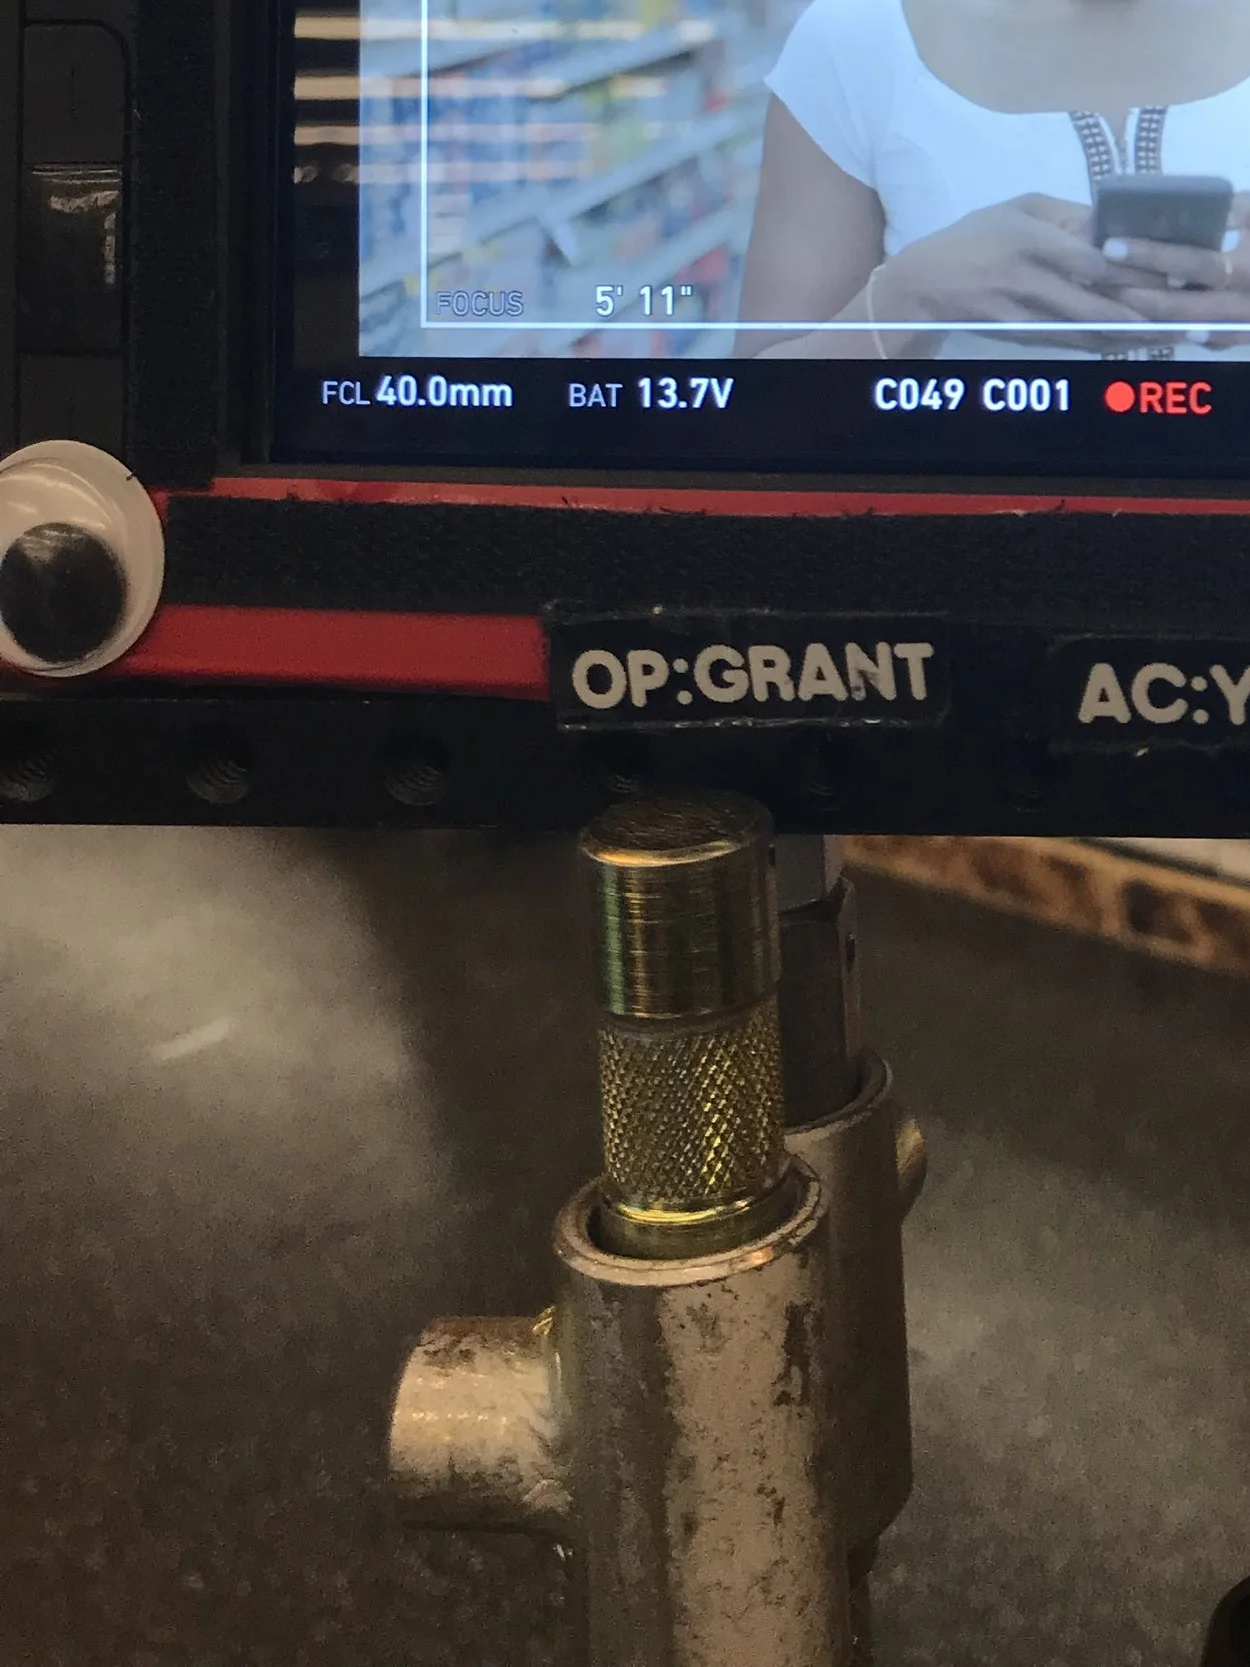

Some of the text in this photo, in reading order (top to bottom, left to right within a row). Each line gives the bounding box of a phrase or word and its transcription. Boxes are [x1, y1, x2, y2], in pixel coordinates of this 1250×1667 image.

[436, 291, 524, 317] FOCUS
[596, 285, 624, 316] 5'
[322, 374, 513, 407] FCL 40.0mm
[568, 376, 734, 410] BAT 13.7V
[873, 377, 1070, 412] C049 C001
[1139, 381, 1213, 415] REC
[572, 643, 934, 708] OP:GRANT
